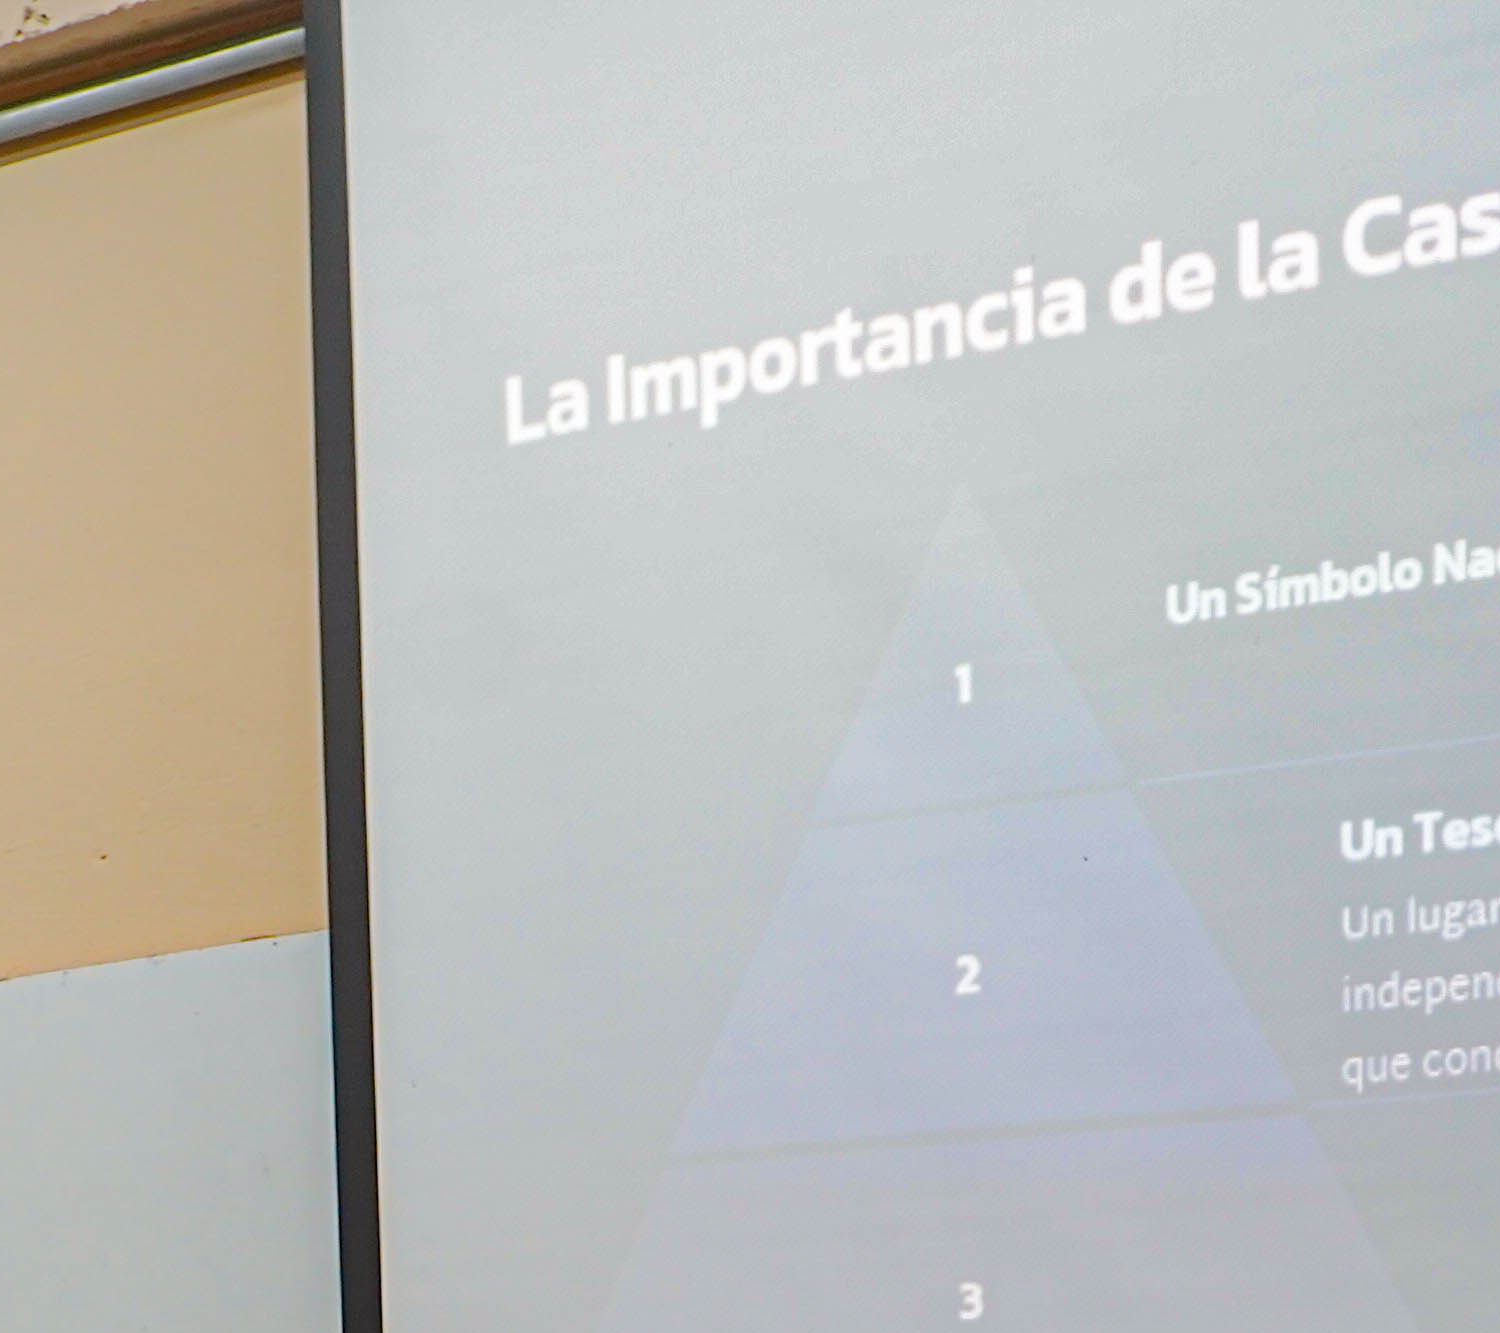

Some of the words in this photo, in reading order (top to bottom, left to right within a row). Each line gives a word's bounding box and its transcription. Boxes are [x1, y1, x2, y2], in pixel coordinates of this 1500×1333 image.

[504, 374, 589, 445] La
[606, 265, 1086, 429] Importancia
[1108, 239, 1216, 324] de
[1237, 218, 1320, 300] la
[1165, 580, 1227, 625] Un
[1234, 550, 1423, 615] Símbolo
[953, 662, 975, 703] 1
[1340, 817, 1404, 861] Un
[1341, 905, 1394, 940] Un
[954, 954, 983, 995] 2
[1340, 1052, 1412, 1094] que
[958, 1282, 985, 1320] 3
